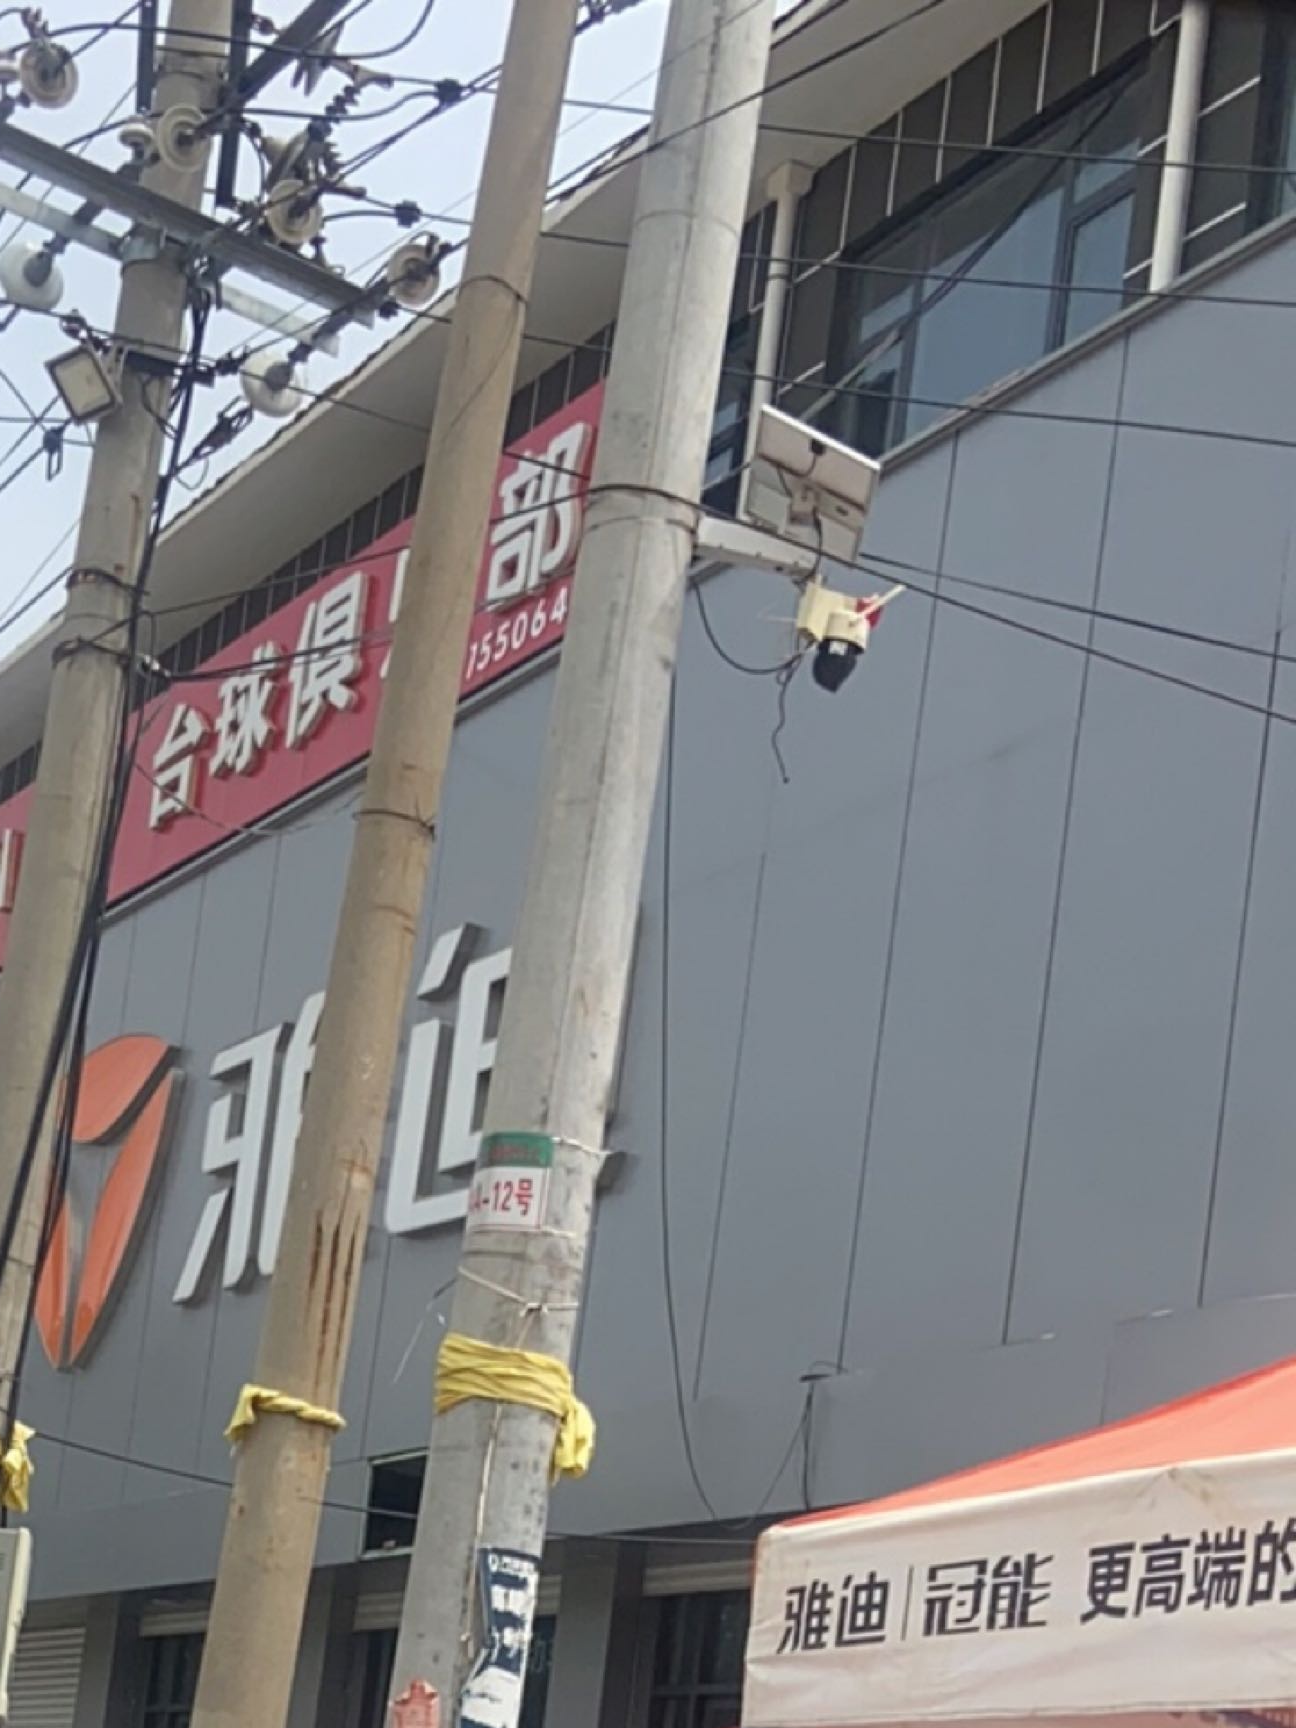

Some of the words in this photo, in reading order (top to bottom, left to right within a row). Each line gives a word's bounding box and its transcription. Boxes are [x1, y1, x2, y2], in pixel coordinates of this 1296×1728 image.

[148, 420, 593, 830] 台球俱部
[777, 1571, 891, 1654] 雅迪
[922, 1553, 1055, 1637] 冠能
[1079, 1517, 1296, 1625] 更高端的
